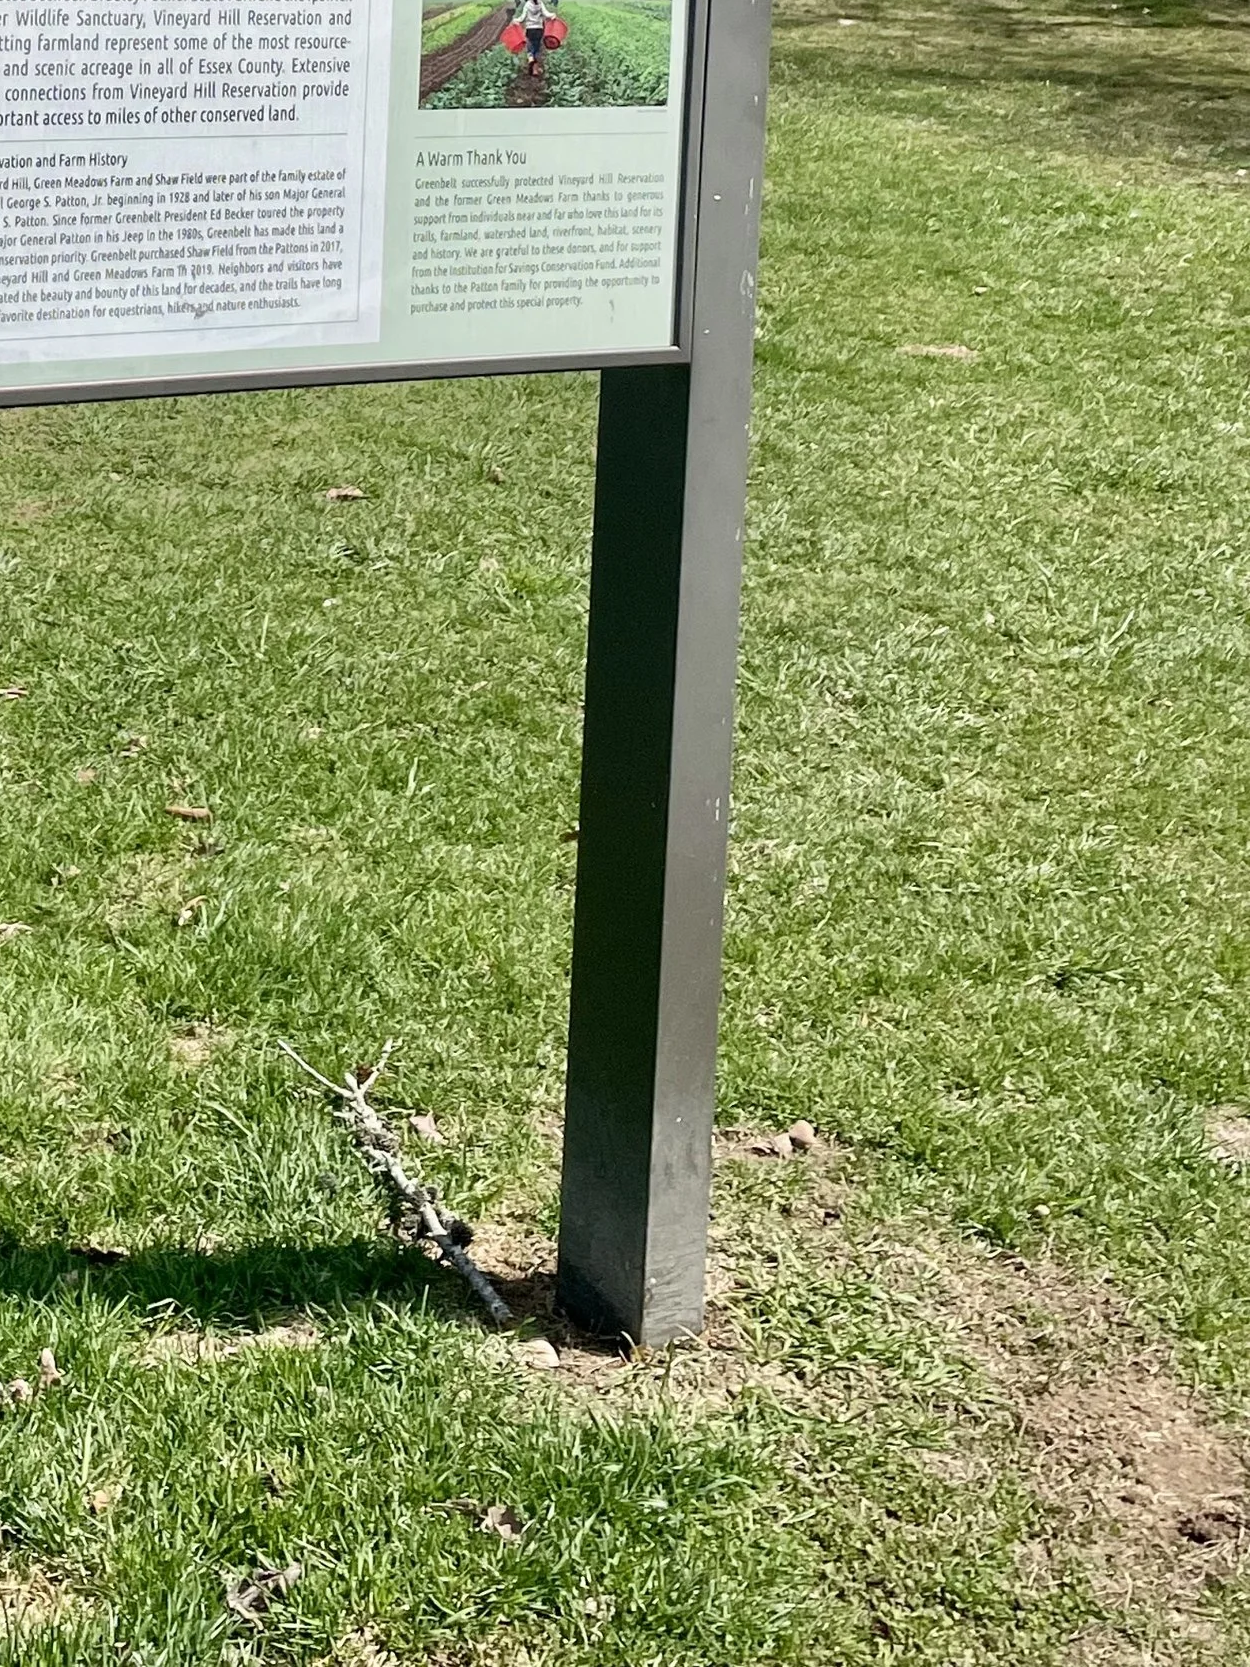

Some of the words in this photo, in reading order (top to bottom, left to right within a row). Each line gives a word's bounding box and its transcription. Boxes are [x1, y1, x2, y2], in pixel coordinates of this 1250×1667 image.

[15, 8, 70, 26] Wildlife
[76, 9, 146, 29] Sanctuary,
[153, 8, 211, 29] Vineyard
[218, 8, 240, 25] Hill
[248, 9, 322, 25] Reservation
[328, 8, 352, 25] and
[38, 32, 99, 51] farmland
[105, 34, 169, 54] represent
[174, 37, 208, 50] some
[213, 31, 227, 50] of
[232, 32, 253, 50] the
[258, 34, 290, 49] most
[294, 36, 351, 49] resource-
[3, 58, 29, 76] and
[34, 58, 76, 76] scenic
[81, 62, 133, 79] acreage
[139, 58, 151, 75] in
[157, 57, 174, 74] all
[179, 56, 194, 74] of
[199, 58, 233, 74] Essex
[238, 57, 285, 77] County.
[292, 56, 350, 73] Extensive
[43, 112, 84, 125] access
[88, 109, 101, 125] to
[105, 106, 141, 124] miles
[144, 105, 159, 123] of
[161, 105, 197, 123] other
[200, 104, 265, 122] conserved
[269, 104, 299, 121] land.
[35, 153, 56, 167] and
[59, 153, 86, 167] Farm
[89, 151, 128, 168] History
[416, 151, 425, 166] A
[428, 151, 463, 166] Warm
[466, 149, 503, 165] Thank
[505, 149, 527, 164] You
